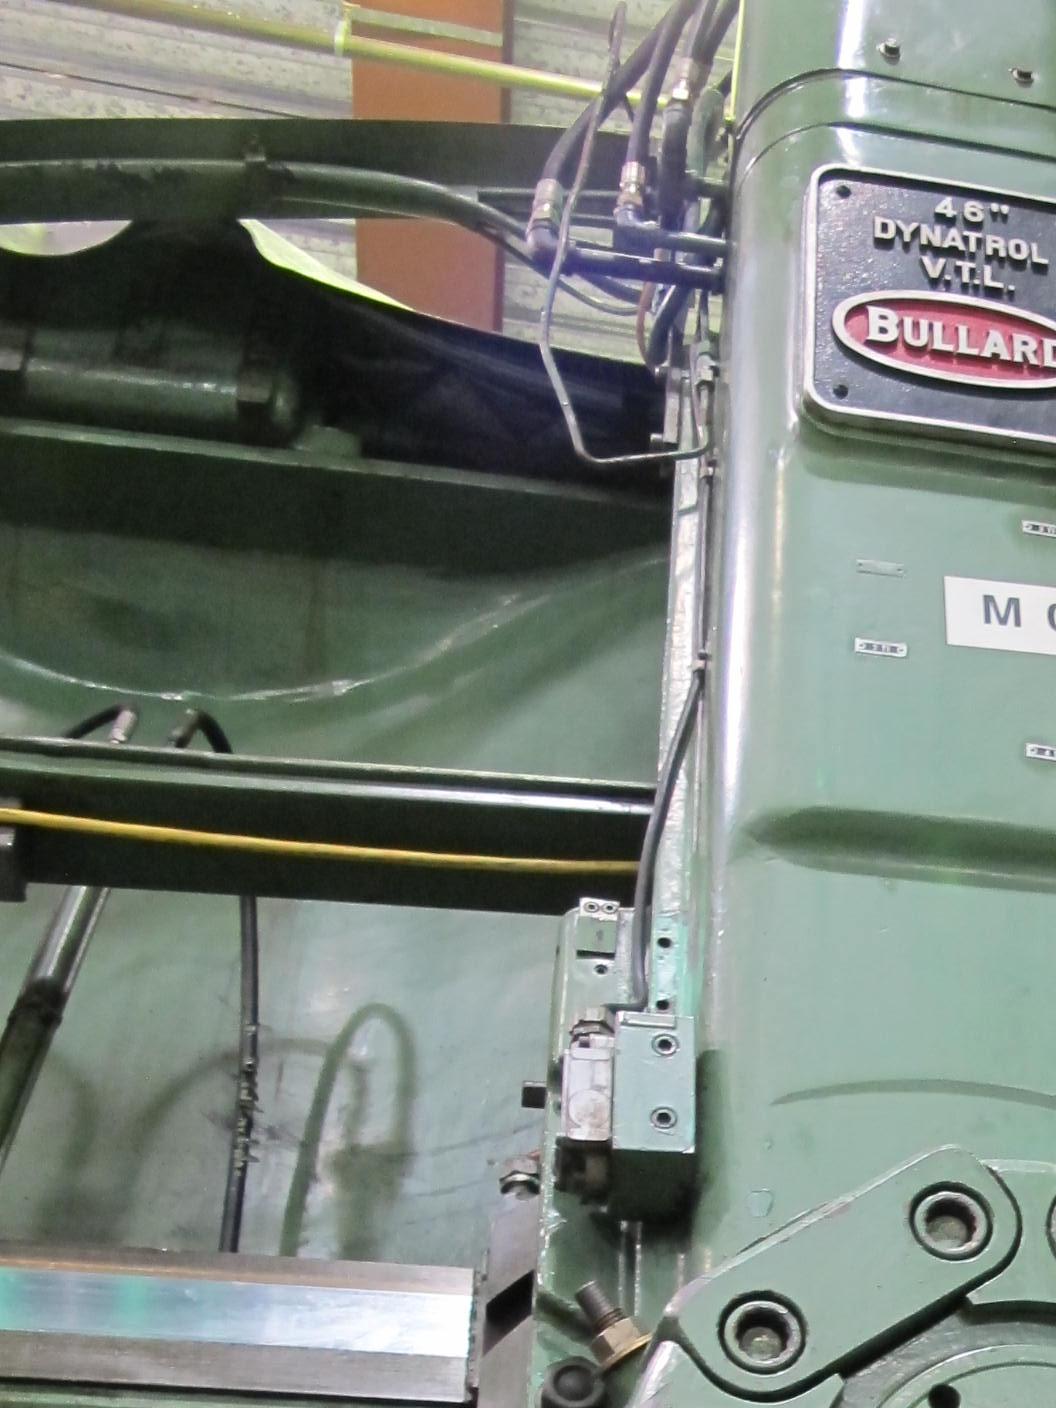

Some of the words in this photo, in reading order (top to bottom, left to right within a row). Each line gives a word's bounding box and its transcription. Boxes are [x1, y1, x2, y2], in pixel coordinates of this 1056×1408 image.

[934, 197, 1010, 223] 46"
[873, 216, 1049, 266] DYNATROL
[920, 256, 1015, 292] V.T.L.
[982, 593, 1022, 628] M
